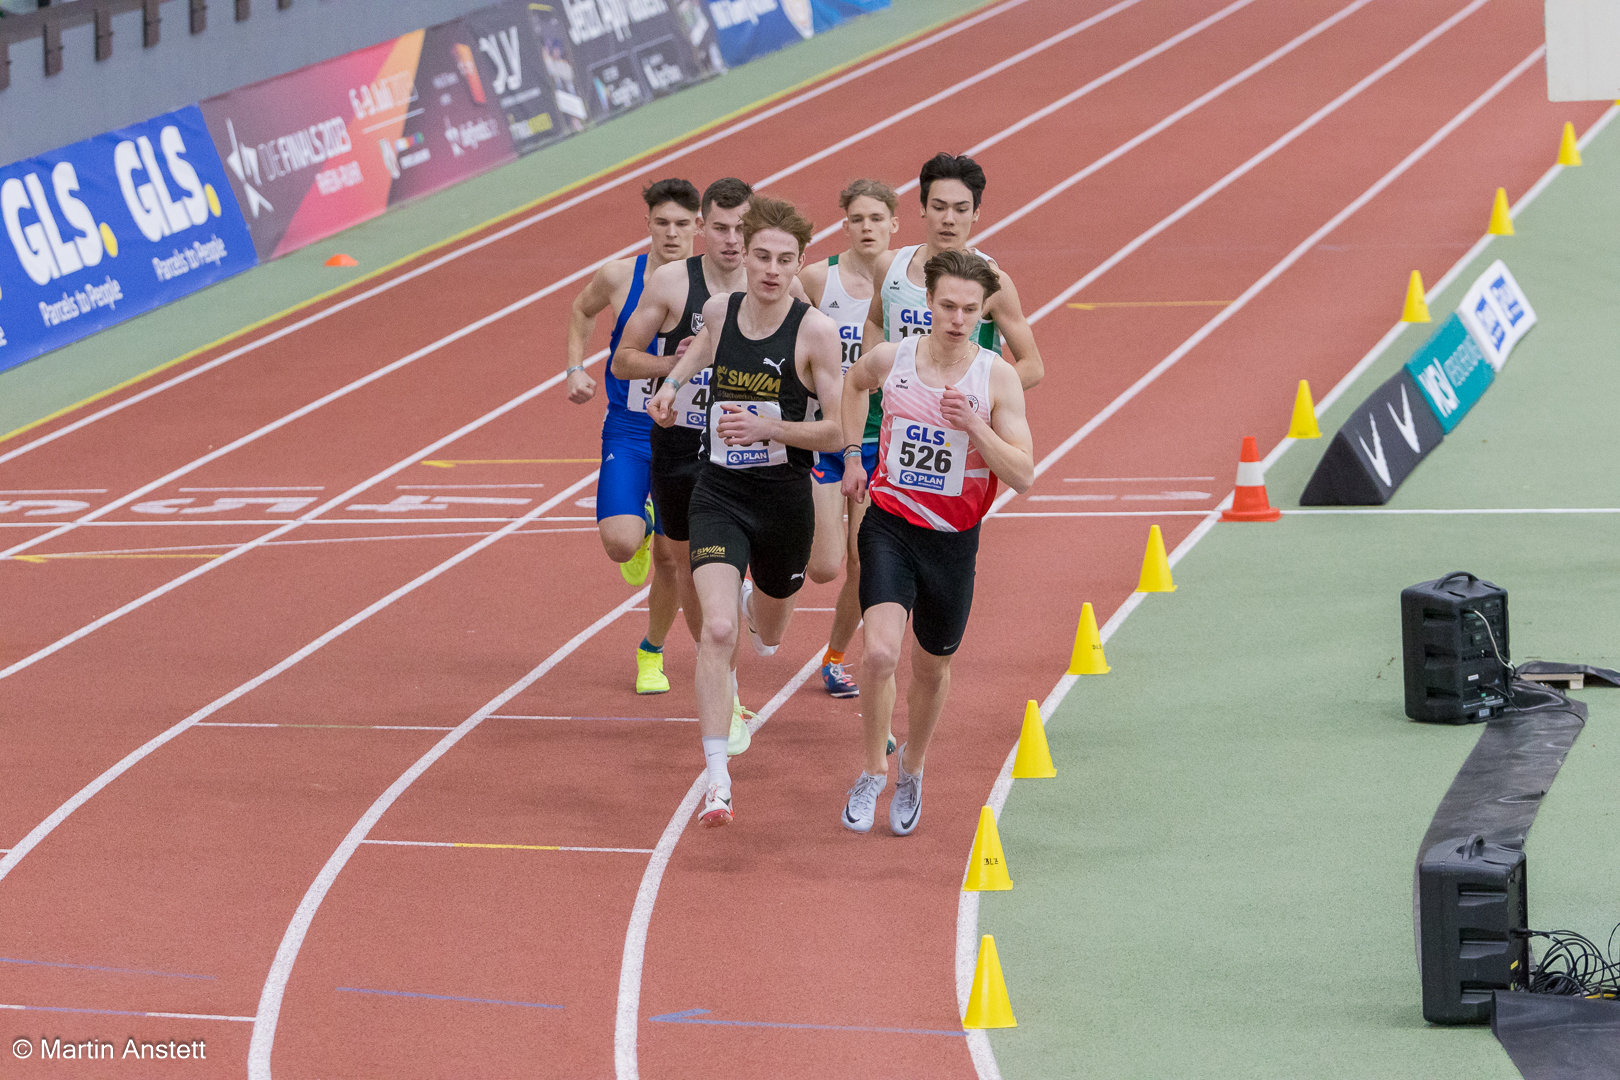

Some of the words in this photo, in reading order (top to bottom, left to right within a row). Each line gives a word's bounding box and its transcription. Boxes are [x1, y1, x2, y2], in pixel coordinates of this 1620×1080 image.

[152, 248, 190, 282] Parcels
[184, 247, 201, 269] to
[193, 233, 228, 267] People
[38, 292, 80, 327] Parcels
[75, 290, 92, 314] to
[85, 275, 124, 311] People
[839, 326, 862, 340] GL
[743, 451, 767, 460] PLAN
[899, 441, 952, 474] 526
[918, 475, 943, 486] PLAN
